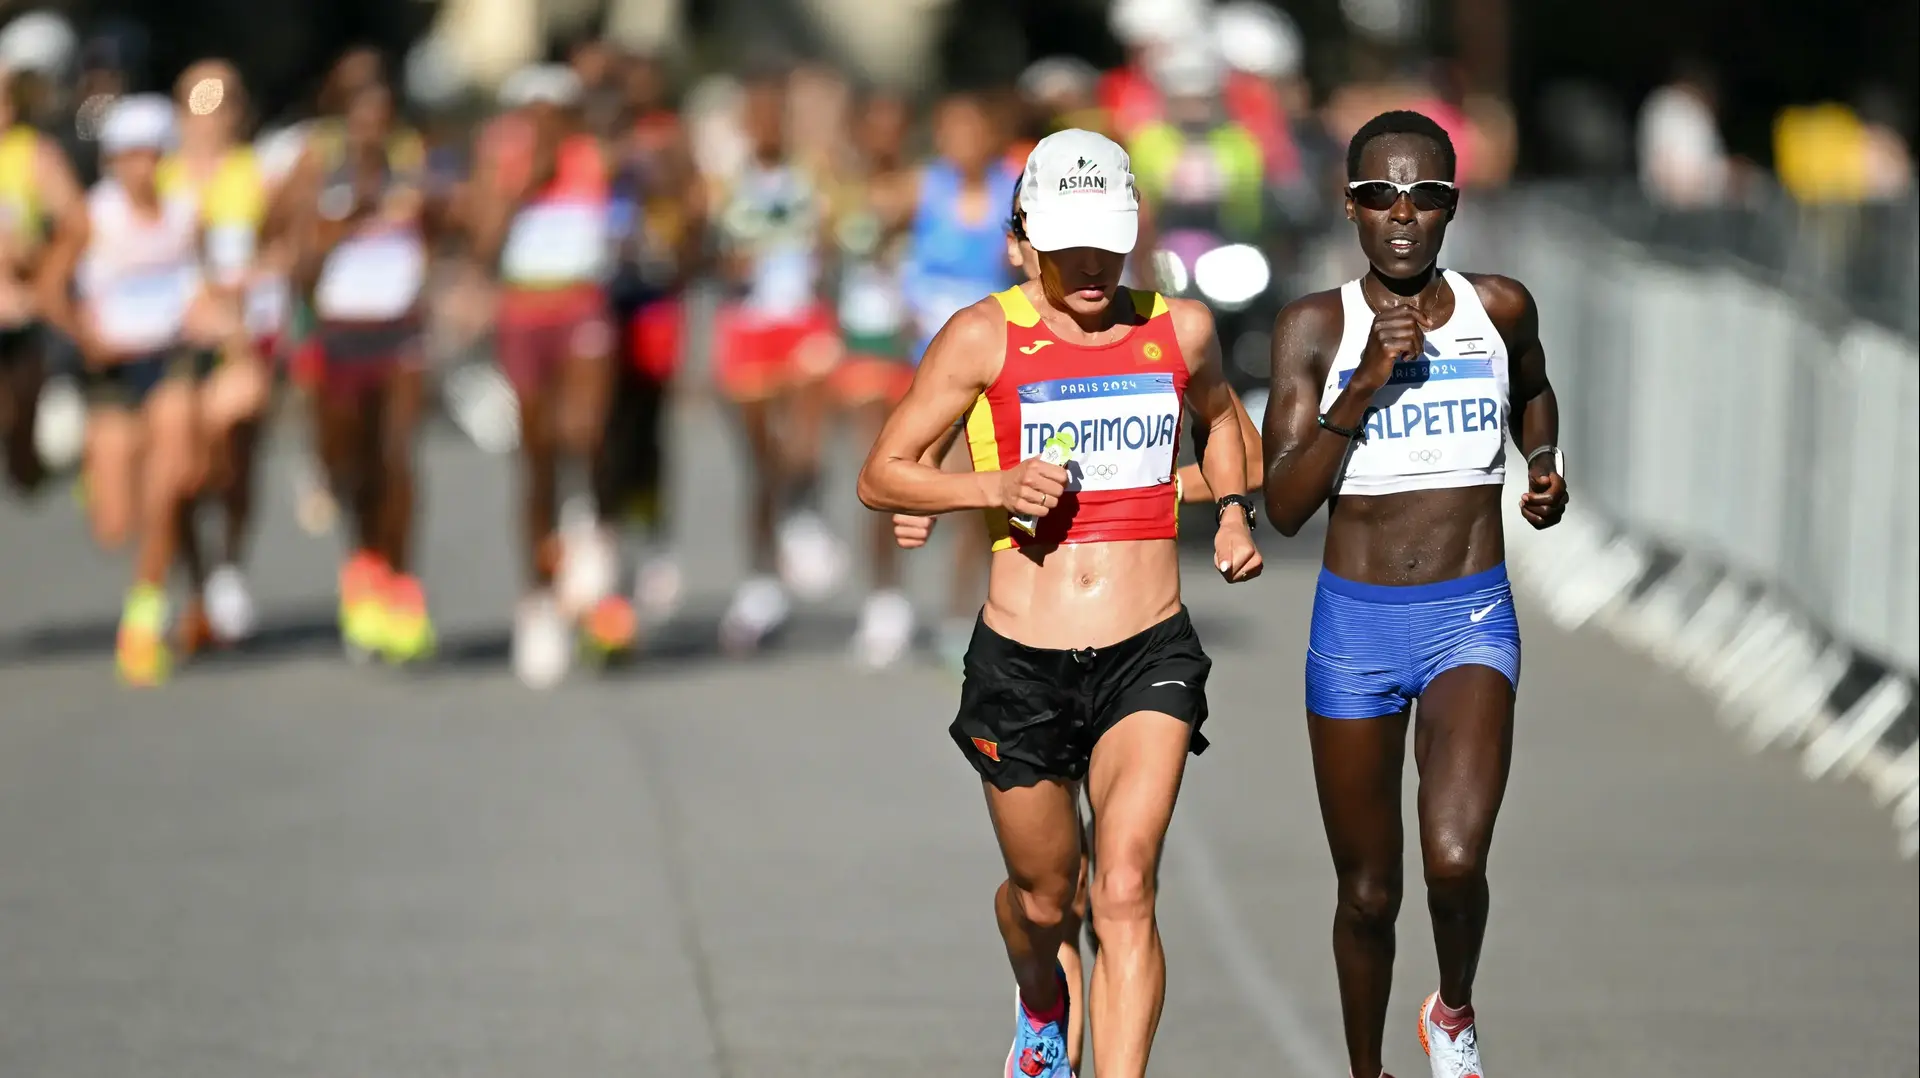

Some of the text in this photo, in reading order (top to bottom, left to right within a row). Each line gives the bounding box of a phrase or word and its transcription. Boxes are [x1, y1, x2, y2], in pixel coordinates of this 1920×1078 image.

[1059, 176, 1104, 191] ASIAN
[1391, 364, 1457, 379] RIS 2024
[1060, 380, 1137, 394] PARIS 2024
[1362, 397, 1498, 440] ALPETER
